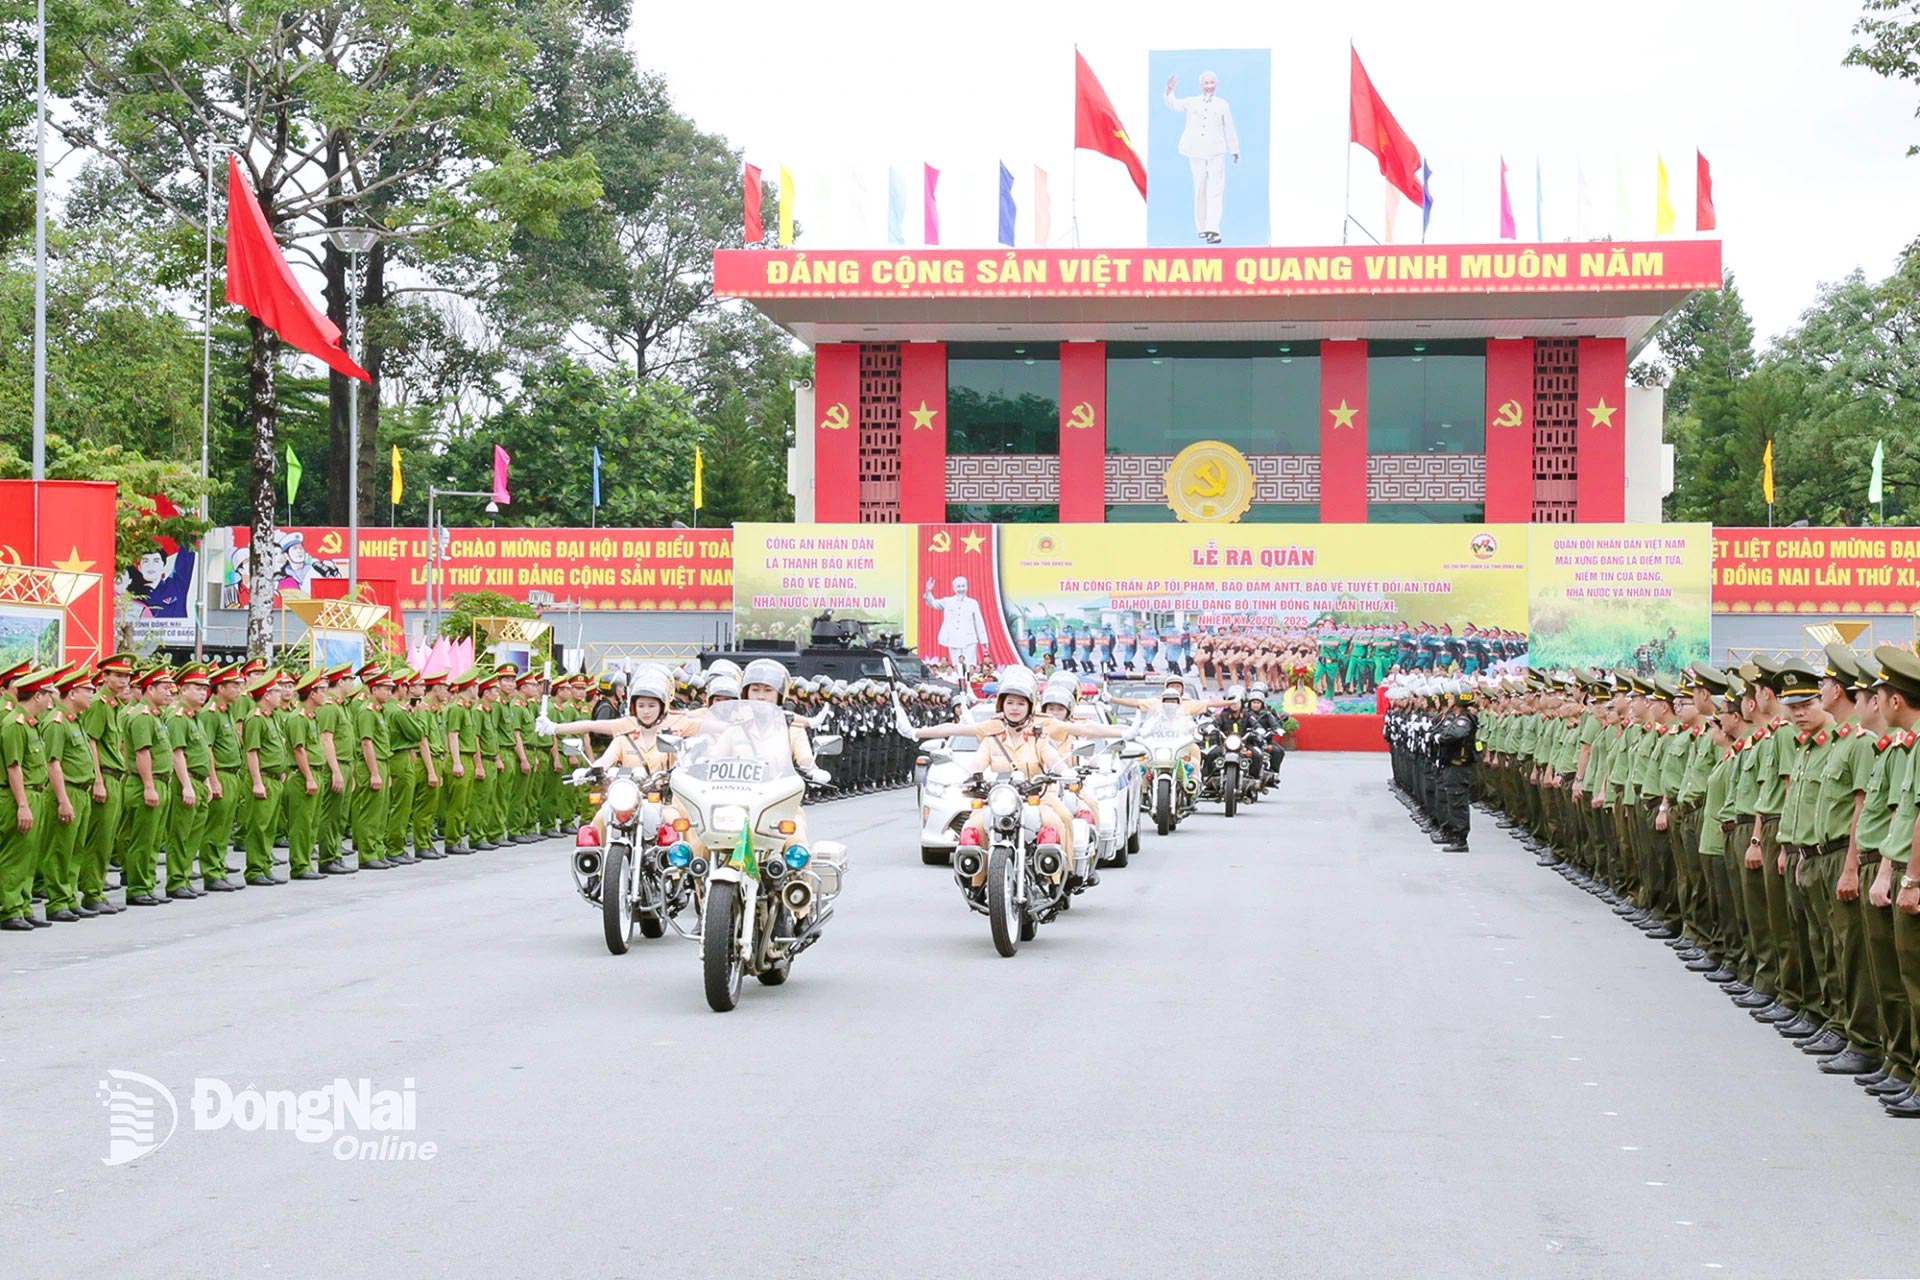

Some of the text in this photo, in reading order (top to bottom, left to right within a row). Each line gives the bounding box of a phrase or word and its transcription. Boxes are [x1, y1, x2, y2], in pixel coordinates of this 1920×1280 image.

[766, 248, 1664, 288] ĐẢNG CỘNG SẢN VIỆT NAM QUANG VINH MUÔN NĂM
[358, 537, 408, 561] NHIỆT
[450, 537, 496, 558] CHÀO
[500, 537, 551, 558] MỪNG
[556, 539, 585, 561] ĐẠI
[589, 537, 618, 561] HỘI
[622, 539, 651, 561] ĐẠI
[655, 534, 694, 558] BIỂU
[766, 536, 874, 550] CÔNG AN NHÂN DÂN
[1665, 540, 1685, 549] NAM
[1734, 537, 1771, 562] LIỆT
[1775, 537, 1825, 558] CHÀO
[1829, 537, 1885, 558] MỪNG
[1192, 541, 1314, 567] LỄ RA QUÂN
[783, 558, 818, 569] THANH
[448, 565, 484, 585] THỨ
[485, 567, 514, 585] XIII
[518, 562, 565, 585] ĐẢNG
[569, 564, 615, 588] CỘNG
[620, 562, 655, 585] SẢN
[661, 565, 696, 589] VIỆT
[1600, 572, 1614, 581] TIN
[1722, 561, 1773, 586] ĐỒNG
[1778, 568, 1810, 586] NAI
[1815, 561, 1851, 586] LẦN
[1856, 564, 1893, 586] THỨ
[1083, 578, 1112, 591] CÔNG
[1147, 579, 1160, 591] ÁP
[1164, 579, 1180, 593] TỘI
[1404, 582, 1419, 592] AN
[779, 594, 809, 608] NƯỚC
[830, 594, 860, 608] NHÂN
[863, 595, 886, 608] DÂN
[1313, 601, 1331, 610] NAI
[1250, 616, 1274, 625] 2020
[1284, 616, 1308, 625] 2025
[709, 763, 762, 781] POLICE
